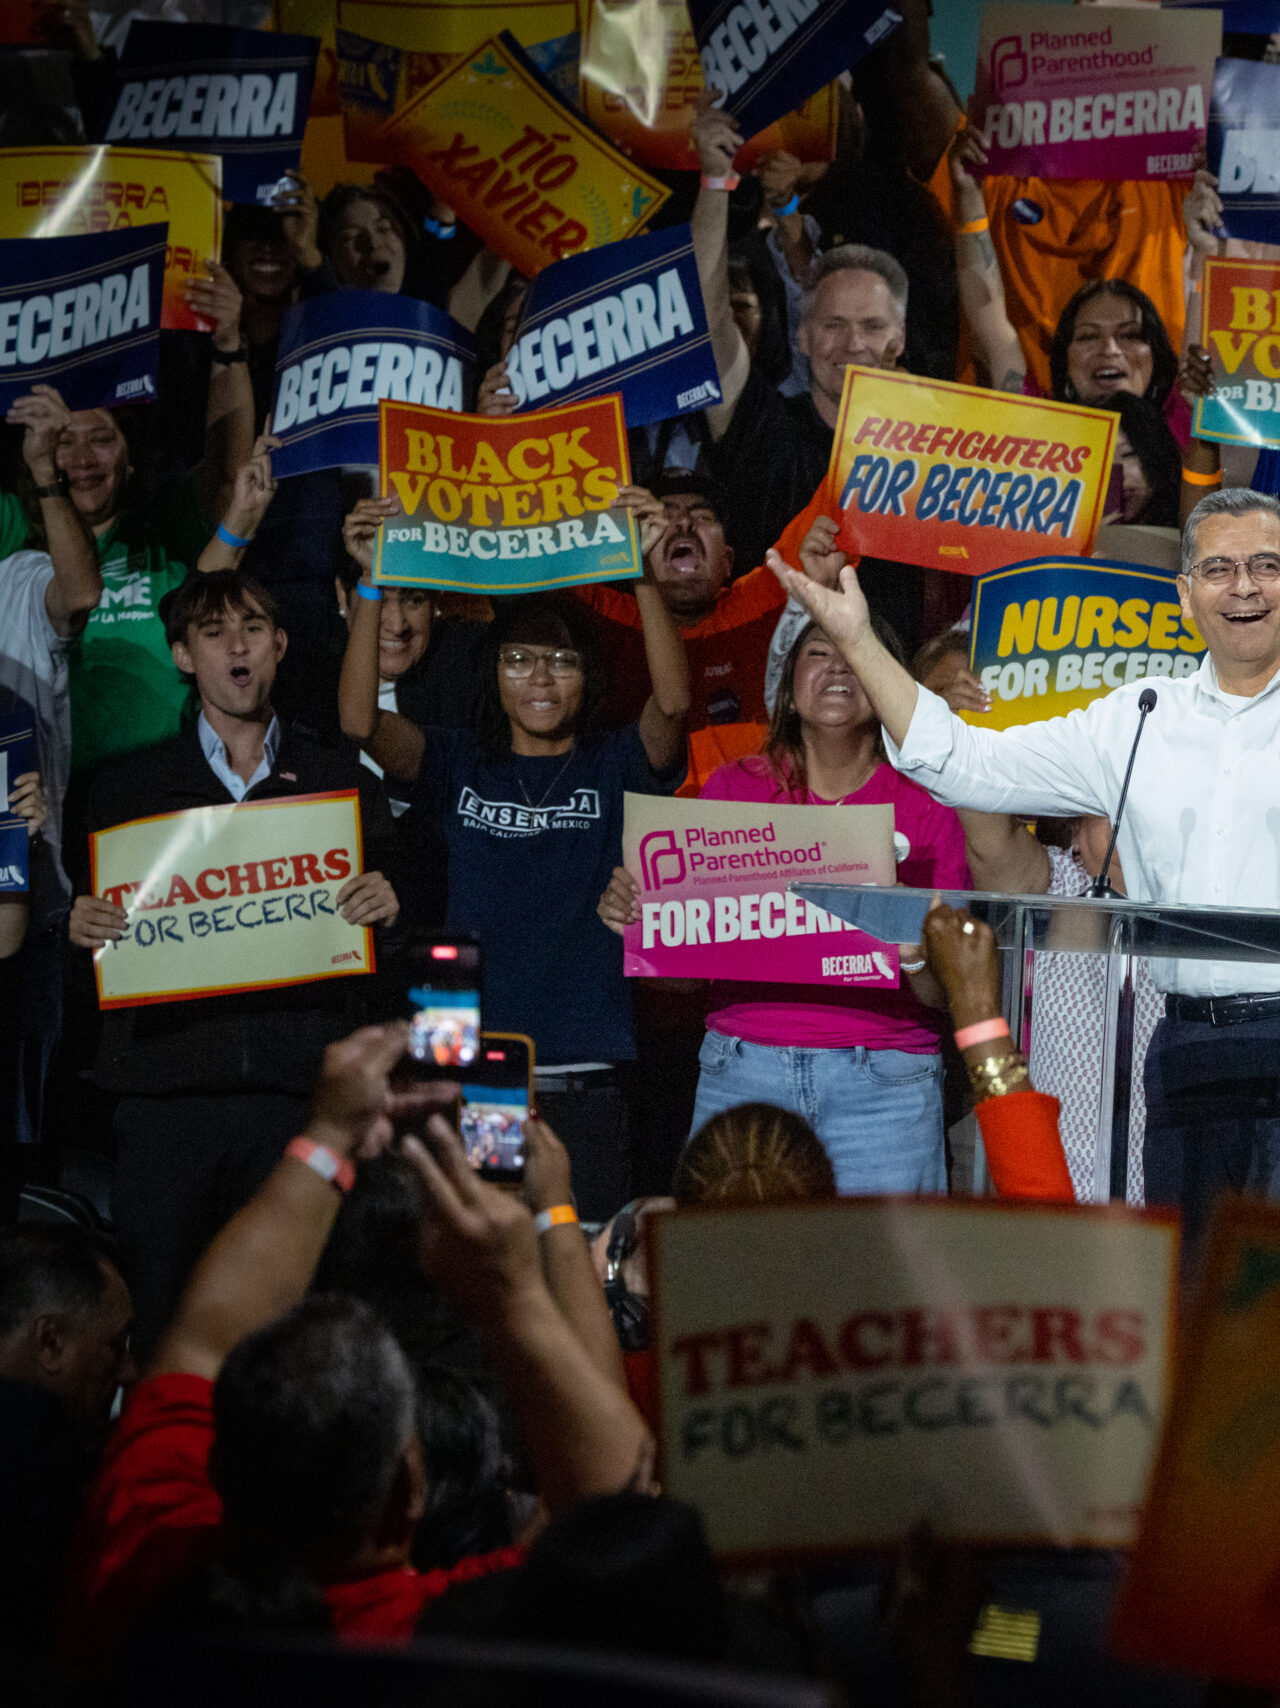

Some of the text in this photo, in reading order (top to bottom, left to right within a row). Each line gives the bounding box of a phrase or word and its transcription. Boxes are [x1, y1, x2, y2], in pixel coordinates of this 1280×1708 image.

[1030, 25, 1112, 50] Planned
[1032, 45, 1156, 74] Parenthood
[104, 72, 298, 141] BECERRA
[984, 84, 1205, 150] FOR BECERRA
[501, 126, 578, 190] TÍO
[428, 133, 587, 259] XAVIER
[0, 262, 150, 367] ECERRA
[496, 267, 695, 410] BECERRA
[273, 342, 465, 434] BECERRA
[404, 426, 599, 484] BLACK
[853, 417, 1092, 475] FIREFIGHTERS
[389, 466, 619, 527] VOTERS
[838, 454, 1087, 539] FOR BECERRA
[387, 527, 422, 544] FOR
[422, 513, 625, 561] BECERRA
[998, 596, 1208, 658] NURSES
[981, 652, 1200, 702] FOR BECERR
[465, 795, 591, 828] ENSENA
[552, 820, 590, 830] MEXICO
[685, 822, 776, 848] Planned
[102, 848, 352, 912] TEACHERS
[690, 842, 822, 872] Parenthood
[693, 872, 728, 886] Planned
[729, 870, 778, 883] Parenthood
[828, 861, 869, 874] California
[189, 889, 342, 938] BECERR
[641, 887, 862, 949] FOR BECER
[821, 954, 873, 977] BECERRA
[672, 1303, 1145, 1397] TEACHERS
[679, 1376, 1151, 1463] FOR BECERRA
